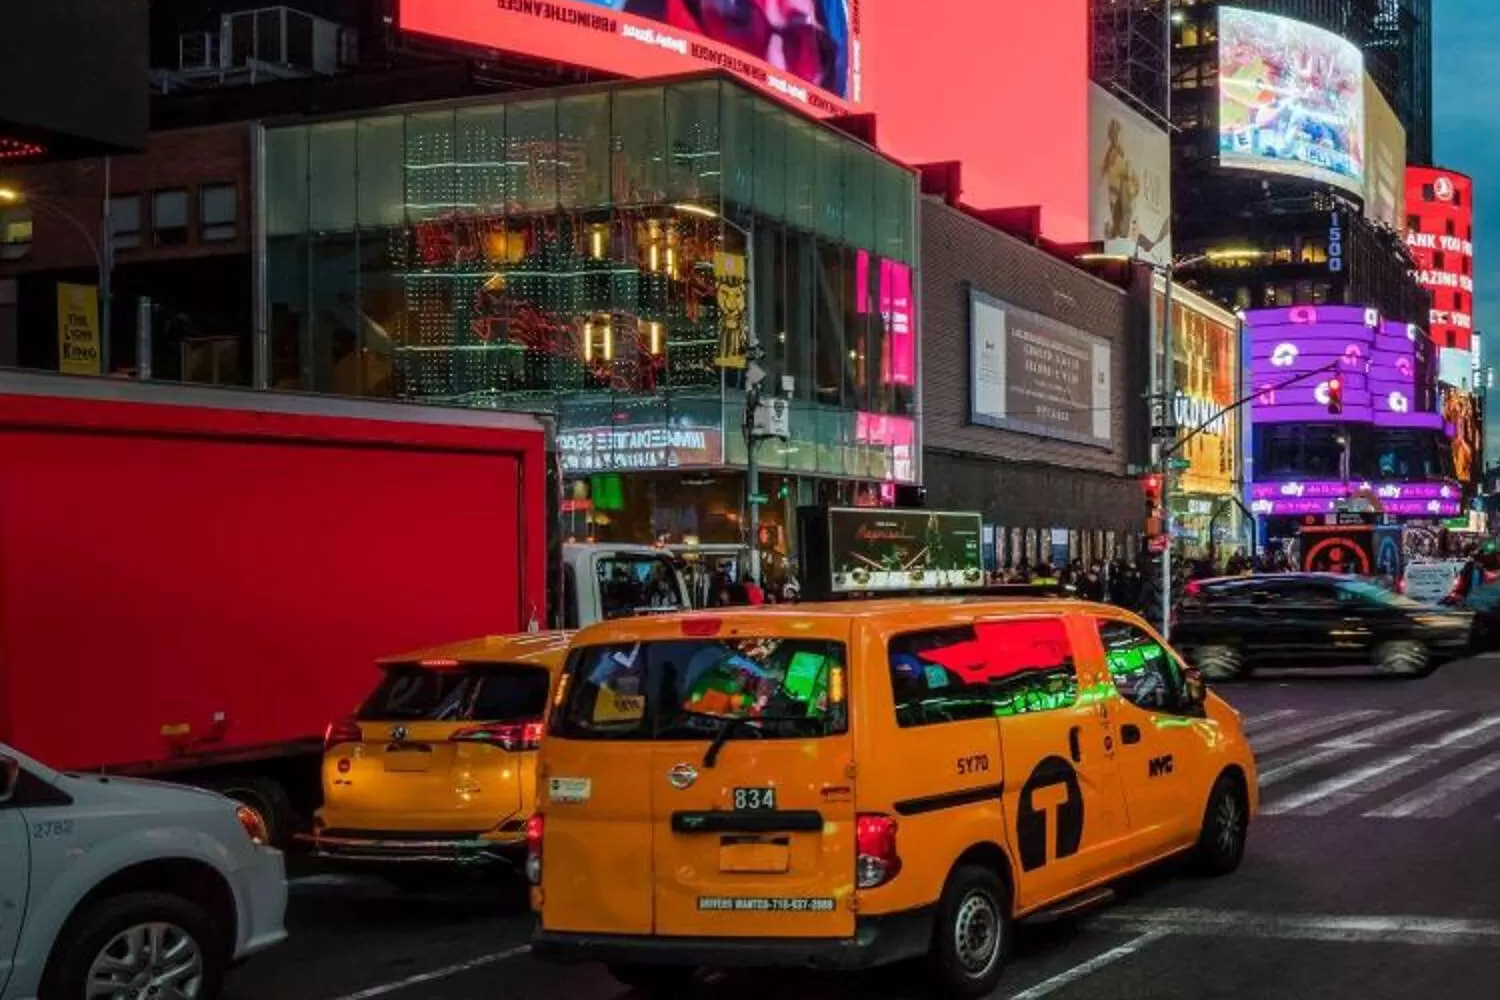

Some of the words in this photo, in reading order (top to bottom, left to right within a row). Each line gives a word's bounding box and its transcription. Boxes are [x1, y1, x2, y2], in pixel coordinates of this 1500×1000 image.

[1328, 211, 1343, 272] 1500
[1405, 232, 1437, 249] ANK
[1148, 754, 1174, 777] NYC
[734, 789, 774, 809] 834
